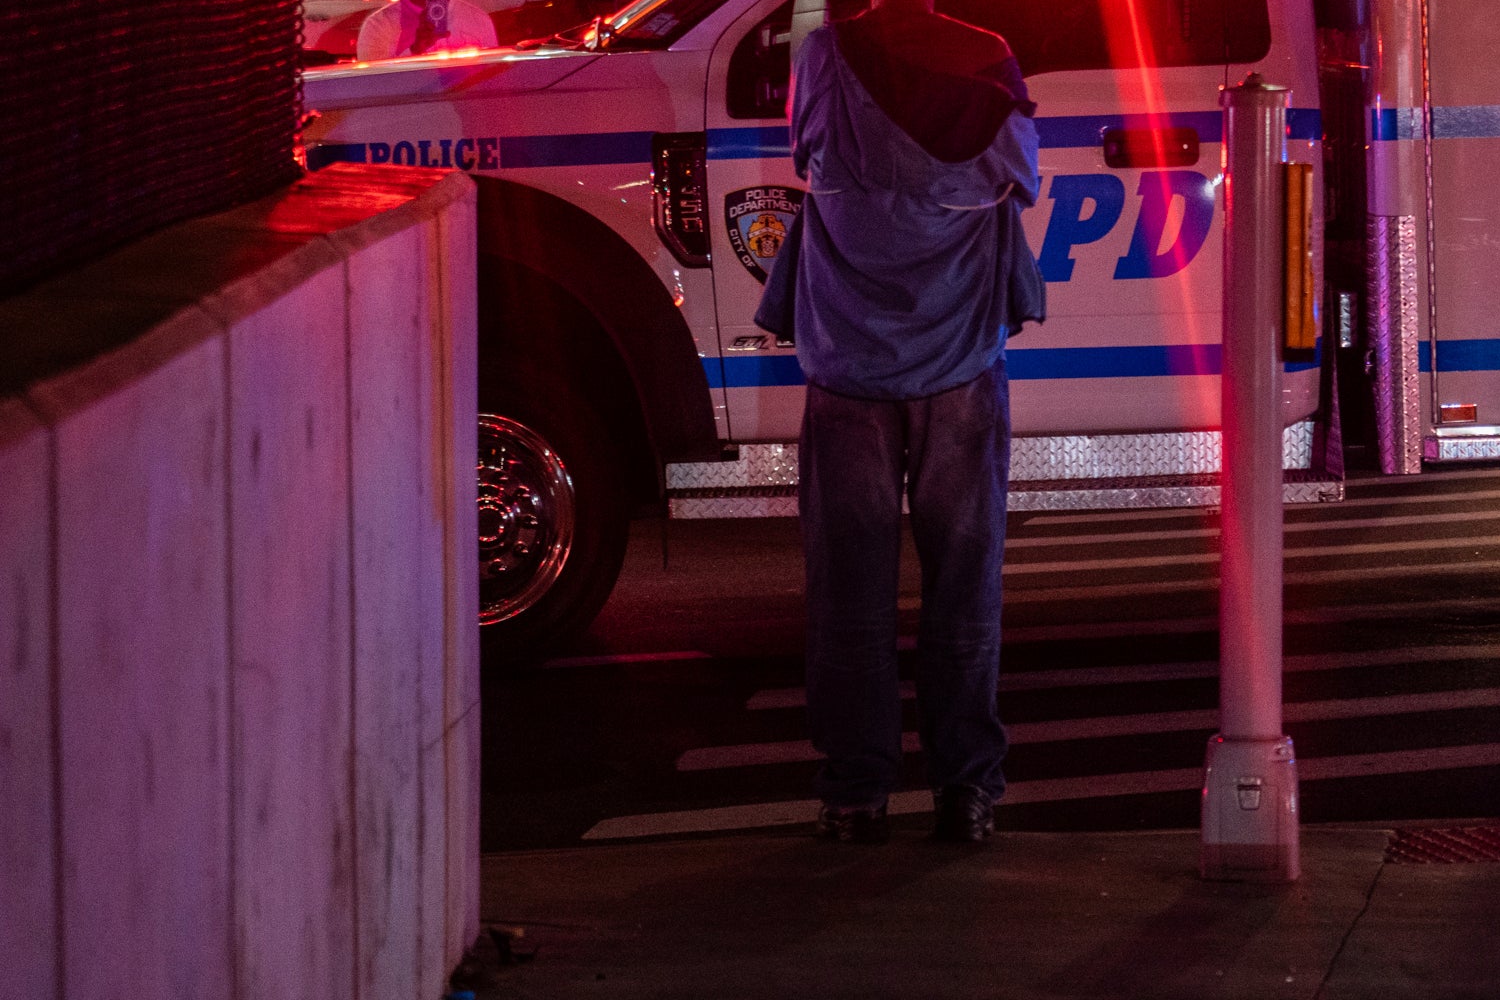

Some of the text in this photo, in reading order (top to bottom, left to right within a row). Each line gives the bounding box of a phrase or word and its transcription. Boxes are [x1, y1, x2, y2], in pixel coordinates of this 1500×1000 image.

[369, 137, 499, 172] POLICE
[745, 188, 787, 201] POLICE
[1036, 170, 1216, 283] PD
[729, 228, 756, 268] CITY OF
